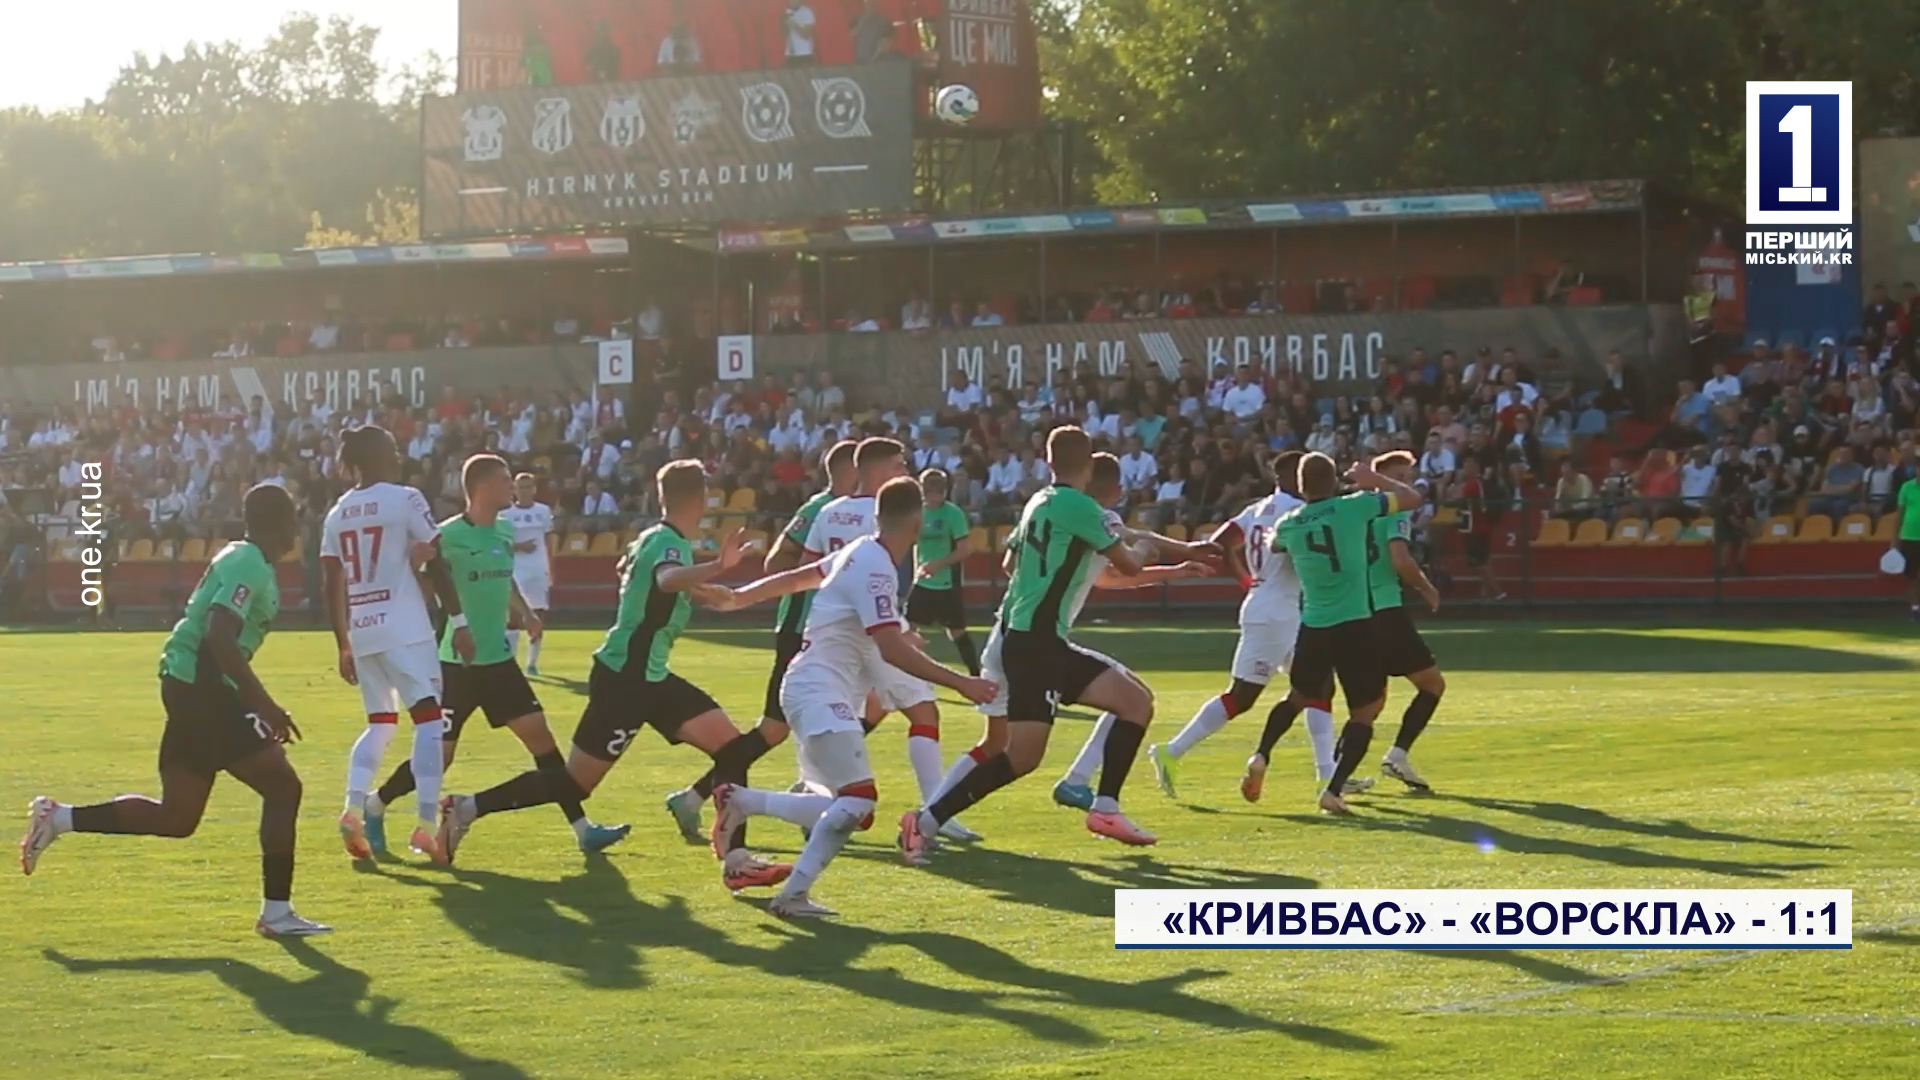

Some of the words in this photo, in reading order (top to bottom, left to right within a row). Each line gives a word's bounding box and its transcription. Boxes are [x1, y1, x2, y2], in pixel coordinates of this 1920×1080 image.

[526, 172, 636, 197] HIRNYK
[658, 162, 794, 188] STADIUM
[609, 355, 623, 376] C
[729, 350, 743, 372] D
[339, 525, 384, 585] 97
[1306, 524, 1341, 573] 4
